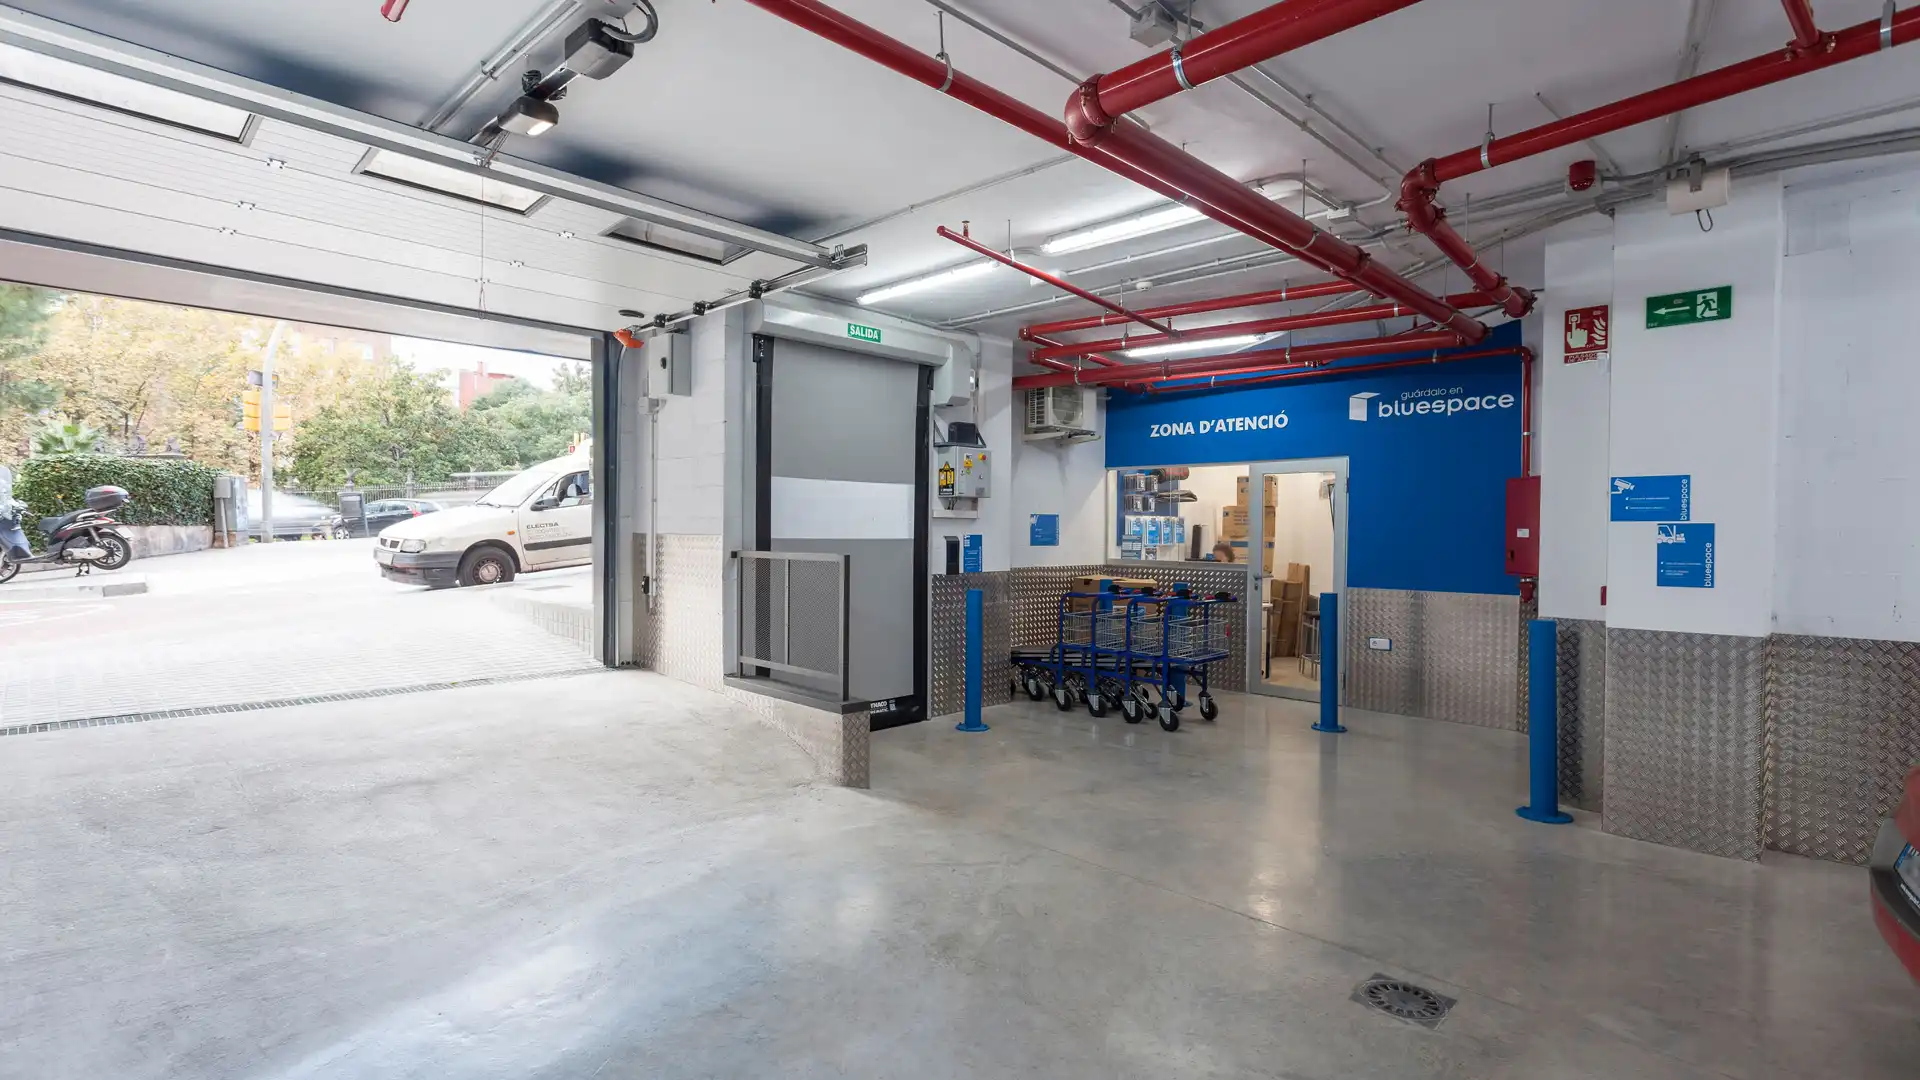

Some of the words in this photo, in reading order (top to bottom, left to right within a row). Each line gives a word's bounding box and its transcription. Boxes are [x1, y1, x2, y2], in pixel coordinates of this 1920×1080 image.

[850, 324, 879, 340] SALIDA
[1378, 393, 1515, 418] bluespace
[1400, 387, 1447, 400] guárdalo
[1449, 386, 1463, 395] en
[1150, 421, 1195, 438] ZONA
[1200, 410, 1288, 434] D'ATENCIÓ
[1680, 478, 1688, 521] bluespace
[1704, 542, 1713, 587] bluespace
